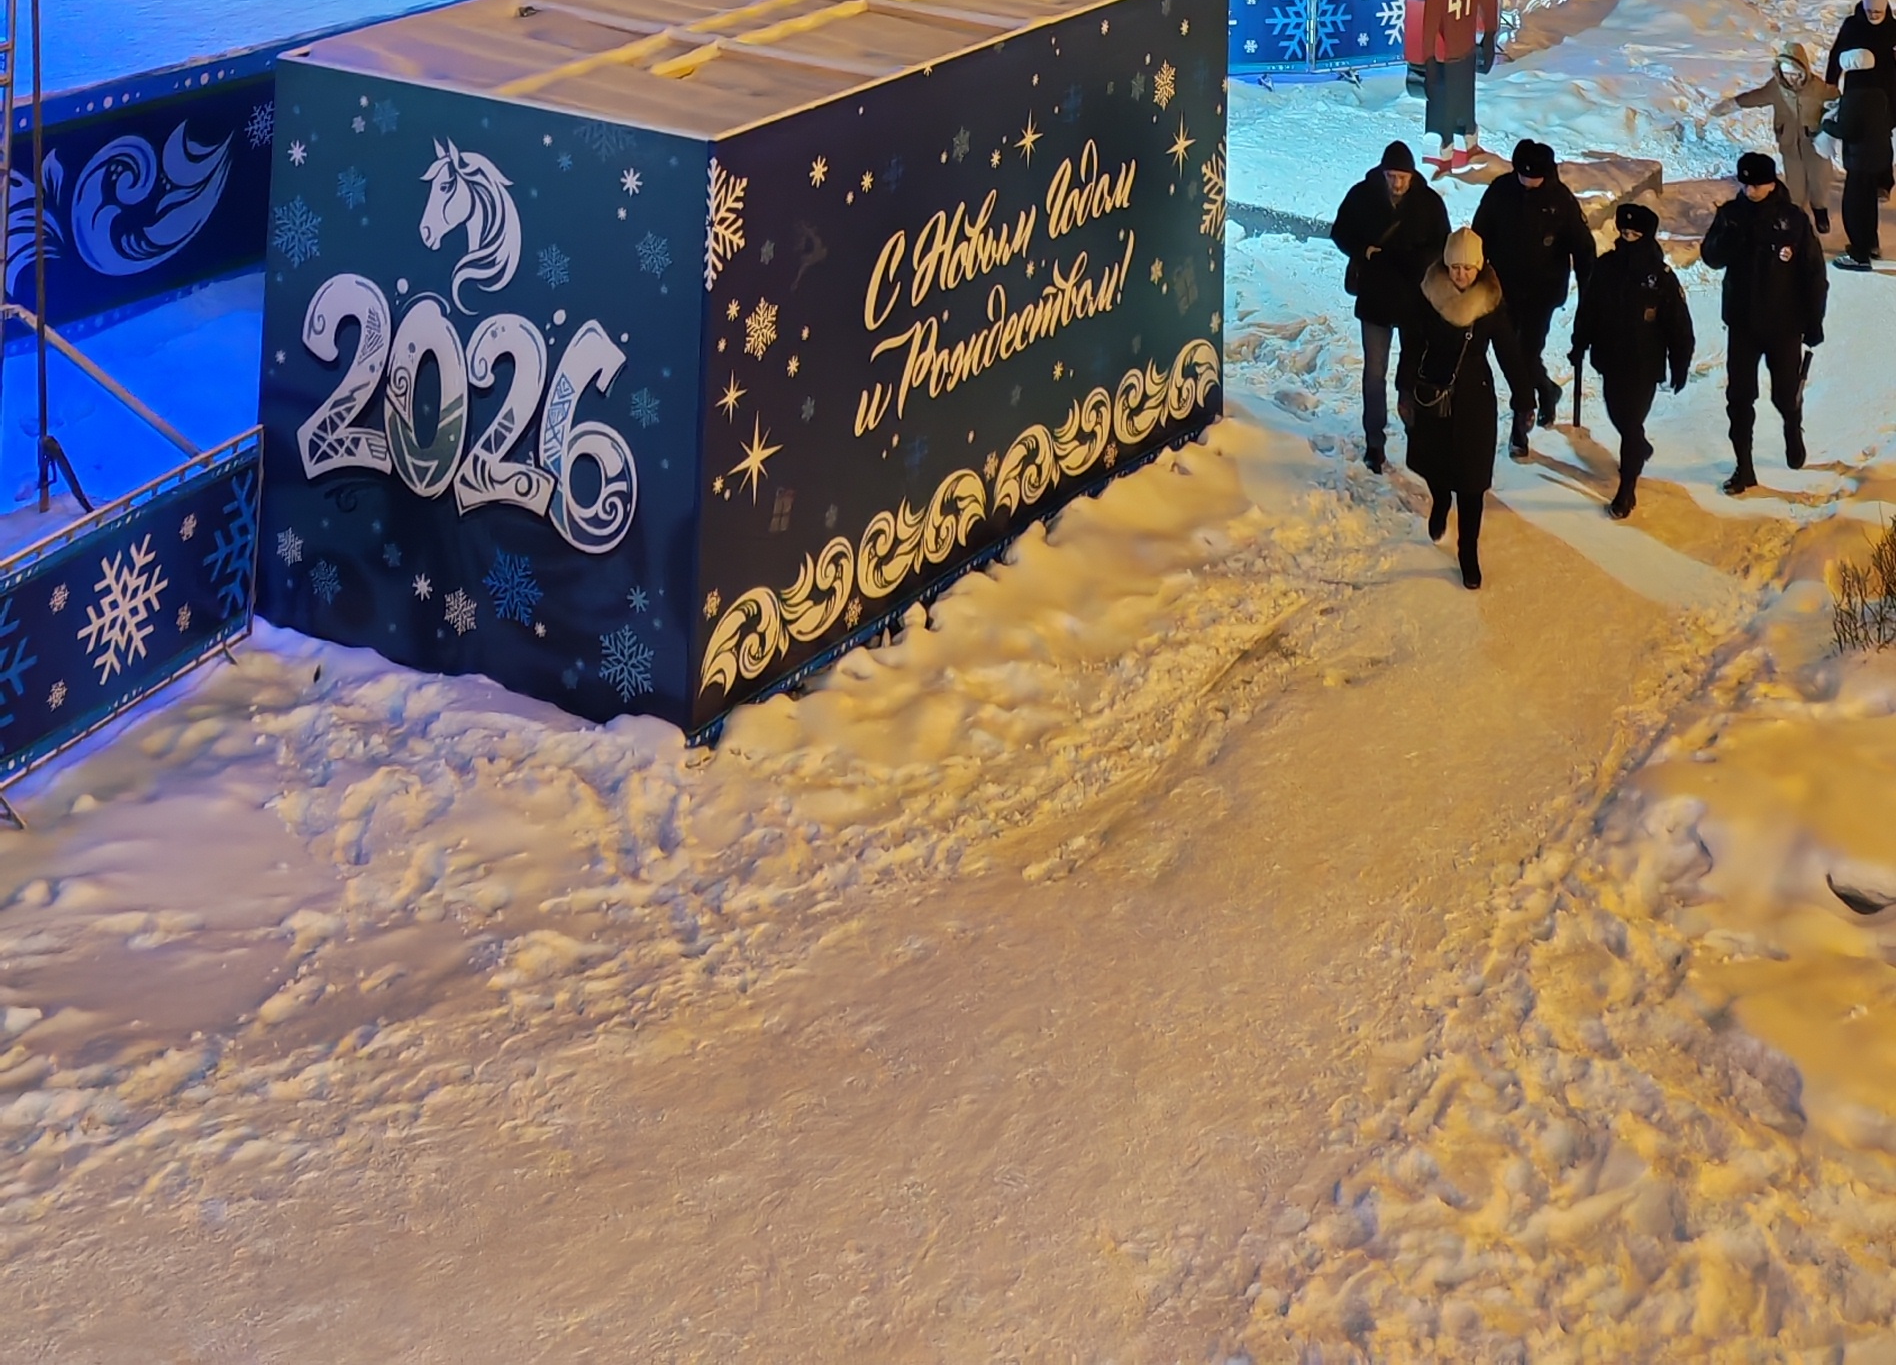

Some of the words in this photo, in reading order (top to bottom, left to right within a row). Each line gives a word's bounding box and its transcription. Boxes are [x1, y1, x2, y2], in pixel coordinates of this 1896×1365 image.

[864, 229, 906, 332] С
[911, 188, 1038, 308] Новым
[869, 228, 1135, 421] Рождеством!
[297, 273, 639, 555] 2026
[853, 381, 893, 438] и
